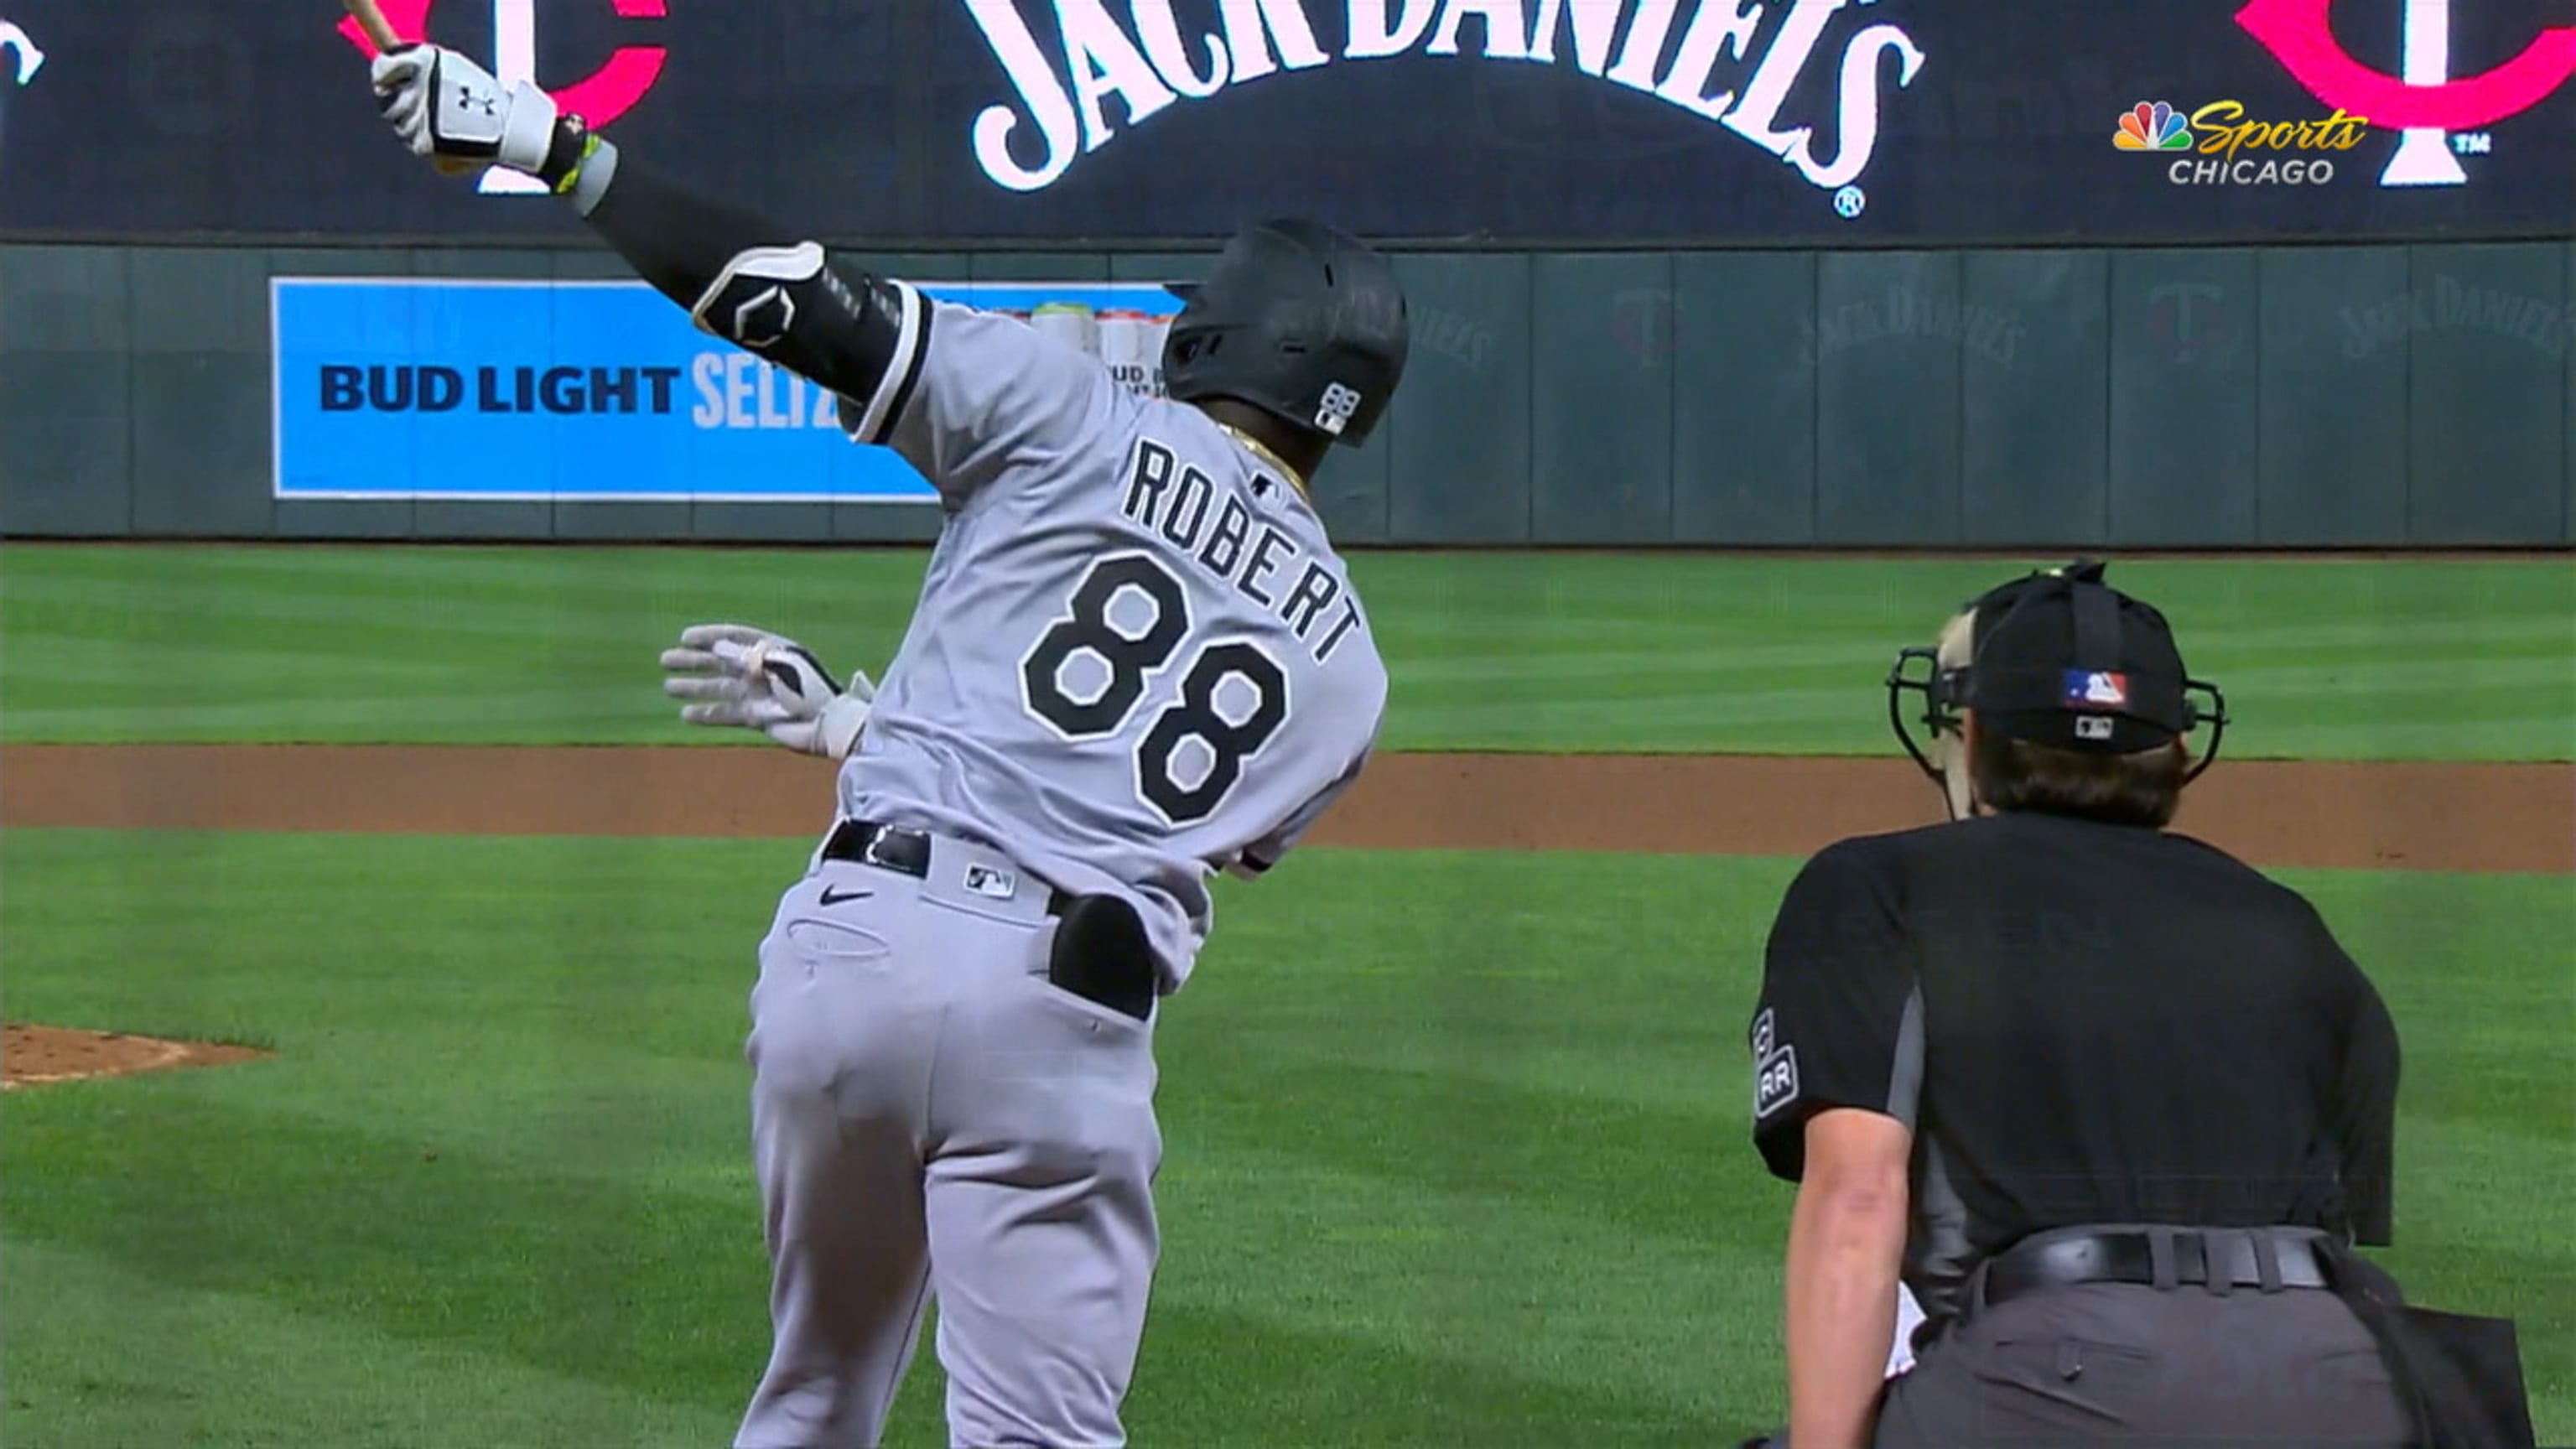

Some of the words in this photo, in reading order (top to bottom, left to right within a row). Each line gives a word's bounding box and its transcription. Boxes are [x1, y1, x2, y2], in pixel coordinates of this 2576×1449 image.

[966, 0, 1331, 191] JACK
[319, 364, 464, 414] BUD
[477, 364, 680, 415] LIGHT
[1111, 364, 1145, 383] UD
[1321, 382, 1362, 417] 88
[1120, 436, 1361, 665] ROBERT
[1018, 548, 1292, 828] 88
